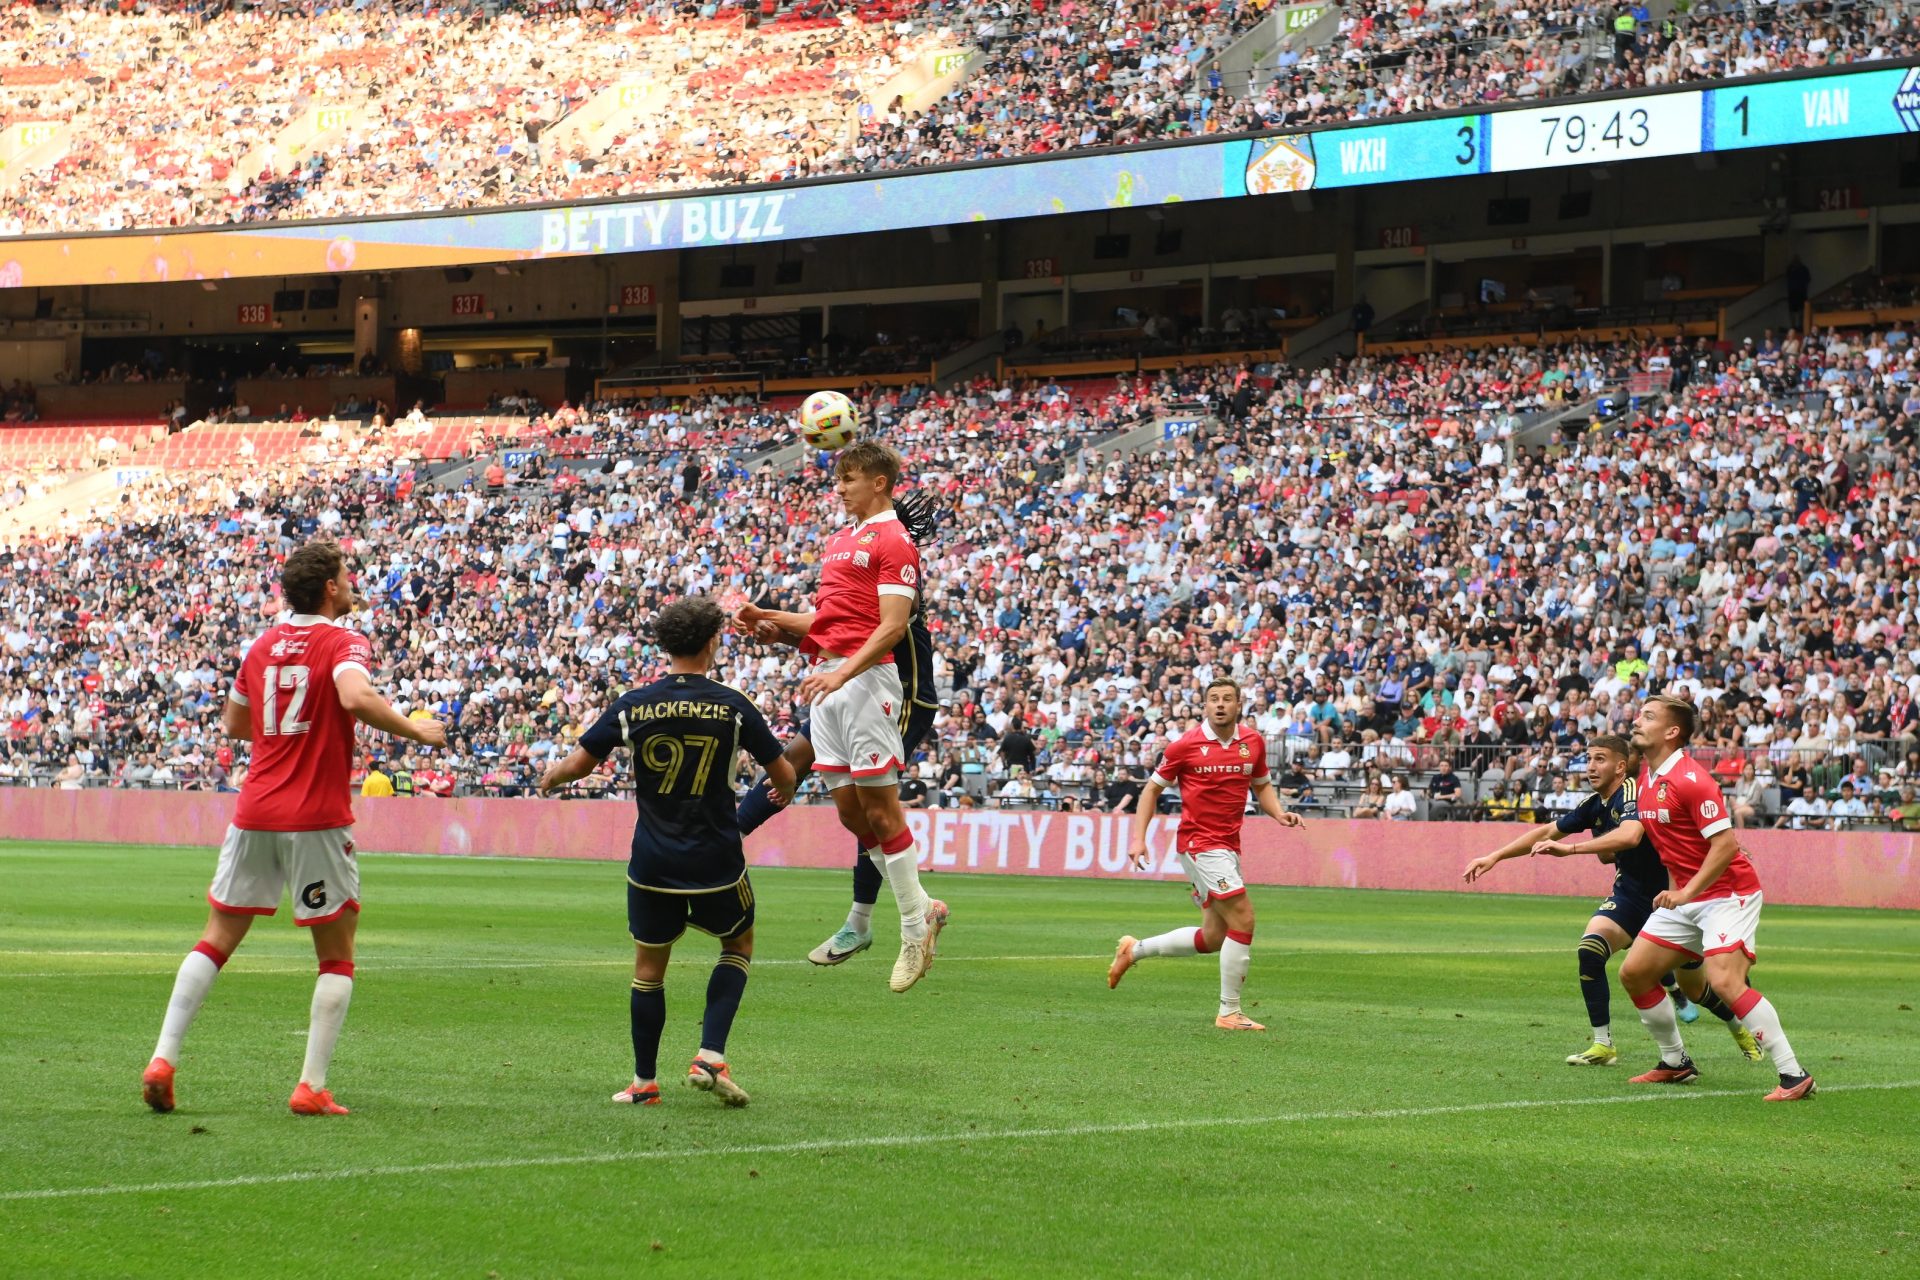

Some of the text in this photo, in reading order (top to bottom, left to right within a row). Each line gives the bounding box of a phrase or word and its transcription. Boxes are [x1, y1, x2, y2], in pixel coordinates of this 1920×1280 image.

[1340, 88, 1849, 175] WXH 3 79:43 1 VAN
[1820, 189, 1850, 211] 341
[542, 205, 670, 252] BETTY
[682, 195, 786, 243] BUZZ
[1383, 228, 1412, 248] 340
[1027, 259, 1052, 278] 339
[456, 295, 479, 313] 337
[625, 286, 649, 305] 338
[242, 305, 265, 322] 336
[902, 565, 916, 583] hp
[263, 665, 312, 736] 12
[630, 700, 730, 721] MACKENZIE
[641, 733, 720, 795] 97
[1194, 765, 1241, 773] UNITED
[1703, 801, 1717, 818] hp
[905, 811, 1051, 869] BETTY
[302, 879, 327, 909] G
